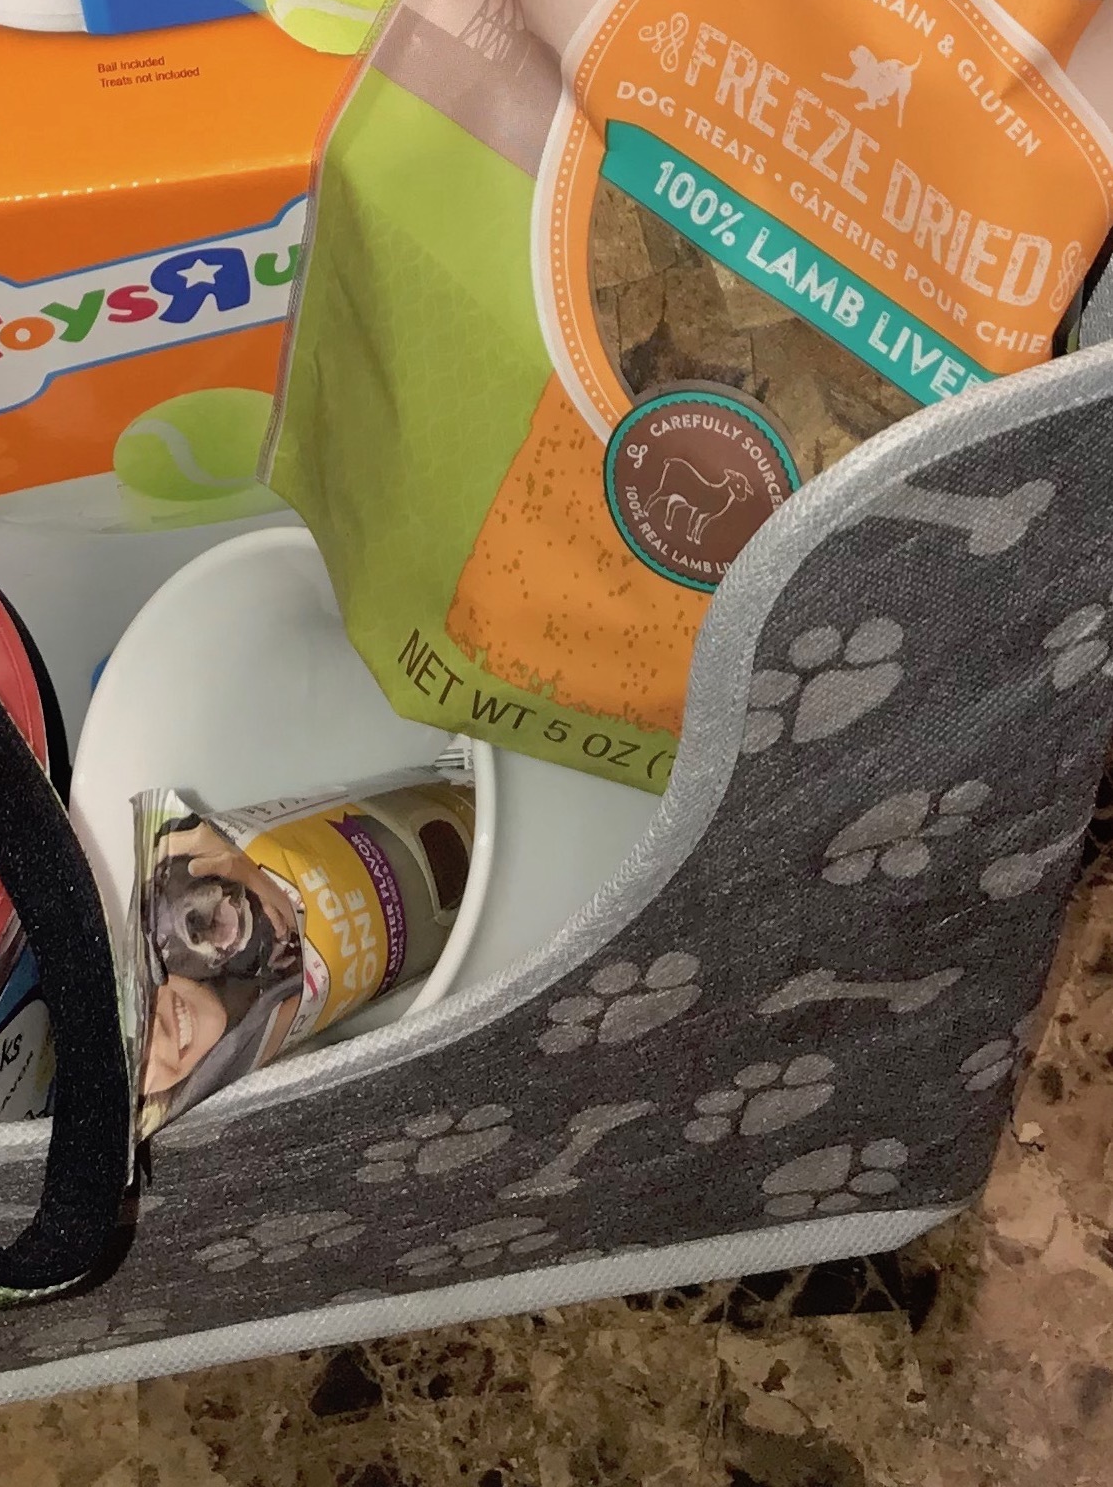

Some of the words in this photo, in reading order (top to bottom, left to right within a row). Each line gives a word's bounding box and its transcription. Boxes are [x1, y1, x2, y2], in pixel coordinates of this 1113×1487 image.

[100, 76, 133, 89] Treats
[135, 72, 154, 84] not
[155, 67, 201, 82] included
[120, 55, 166, 71] included
[936, 33, 956, 60] &
[956, 57, 1044, 160] GLUTEN
[684, 22, 881, 205] FREEZE
[881, 158, 1054, 309] DRIED
[616, 80, 676, 119] DOG
[684, 107, 769, 175] TREATS
[903, 264, 969, 328] POUR
[975, 319, 1049, 355] CHIE
[653, 160, 746, 247] 100%
[745, 226, 866, 329] LAMB
[649, 413, 744, 441] CAREFULLY
[741, 436, 785, 512] SOURCE
[625, 484, 645, 521] 100%
[639, 520, 669, 556] REAL
[671, 549, 713, 574] LAMB
[397, 627, 465, 706] NET
[470, 688, 537, 730] WT
[542, 718, 573, 744] 5
[581, 733, 641, 768] OZ
[350, 833, 390, 899] FLAVOR
[344, 888, 378, 990] ONE
